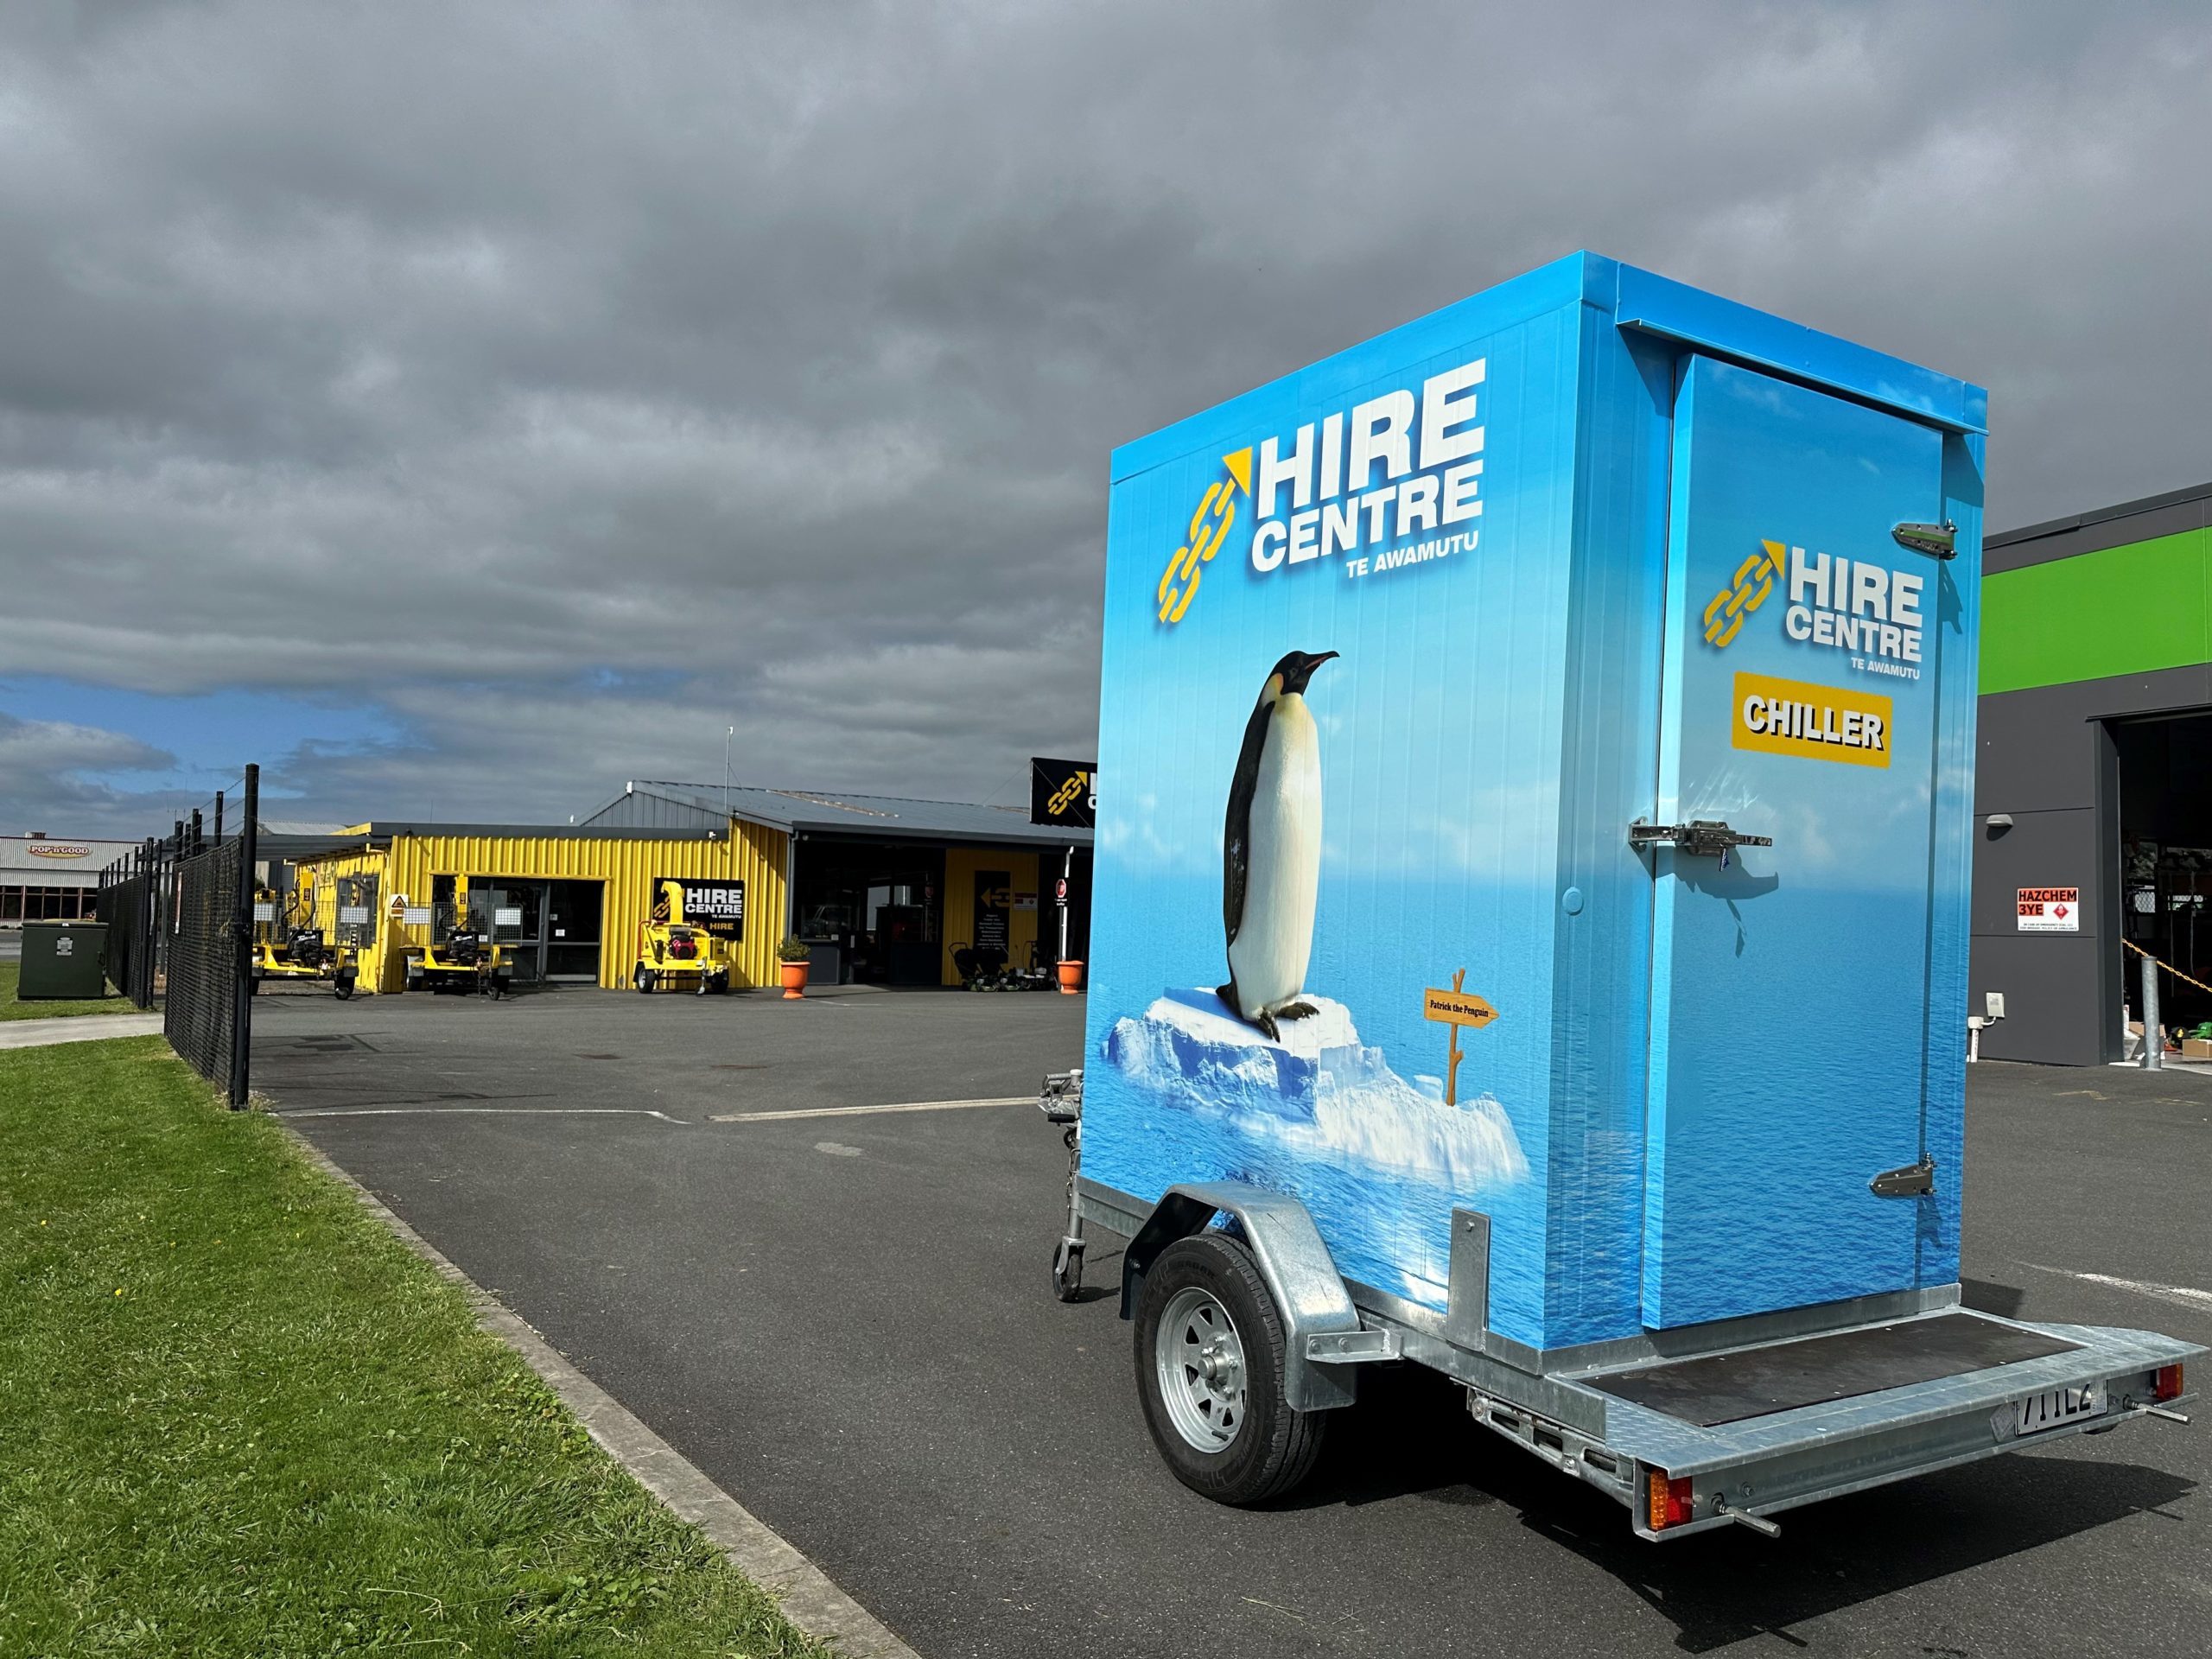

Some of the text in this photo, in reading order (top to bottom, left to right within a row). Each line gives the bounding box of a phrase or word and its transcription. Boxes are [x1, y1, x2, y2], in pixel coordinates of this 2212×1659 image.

[1258, 358, 1486, 520] HIRE
[1251, 459, 1484, 572] CENTRE
[1346, 531, 1479, 578] TE AWAMUTU
[1789, 546, 1923, 628] HIRE
[1786, 606, 1923, 663] CENTRE
[1851, 657, 1920, 680] TE AWAMUTU
[1743, 695, 1884, 751] CHILLER
[684, 904, 742, 913] CENTRE
[686, 888, 742, 904] HIRE
[2018, 890, 2077, 902] HAZCHEM
[2018, 904, 2044, 915] 3YE
[1430, 1000, 1489, 1018] Patrick the Penguin
